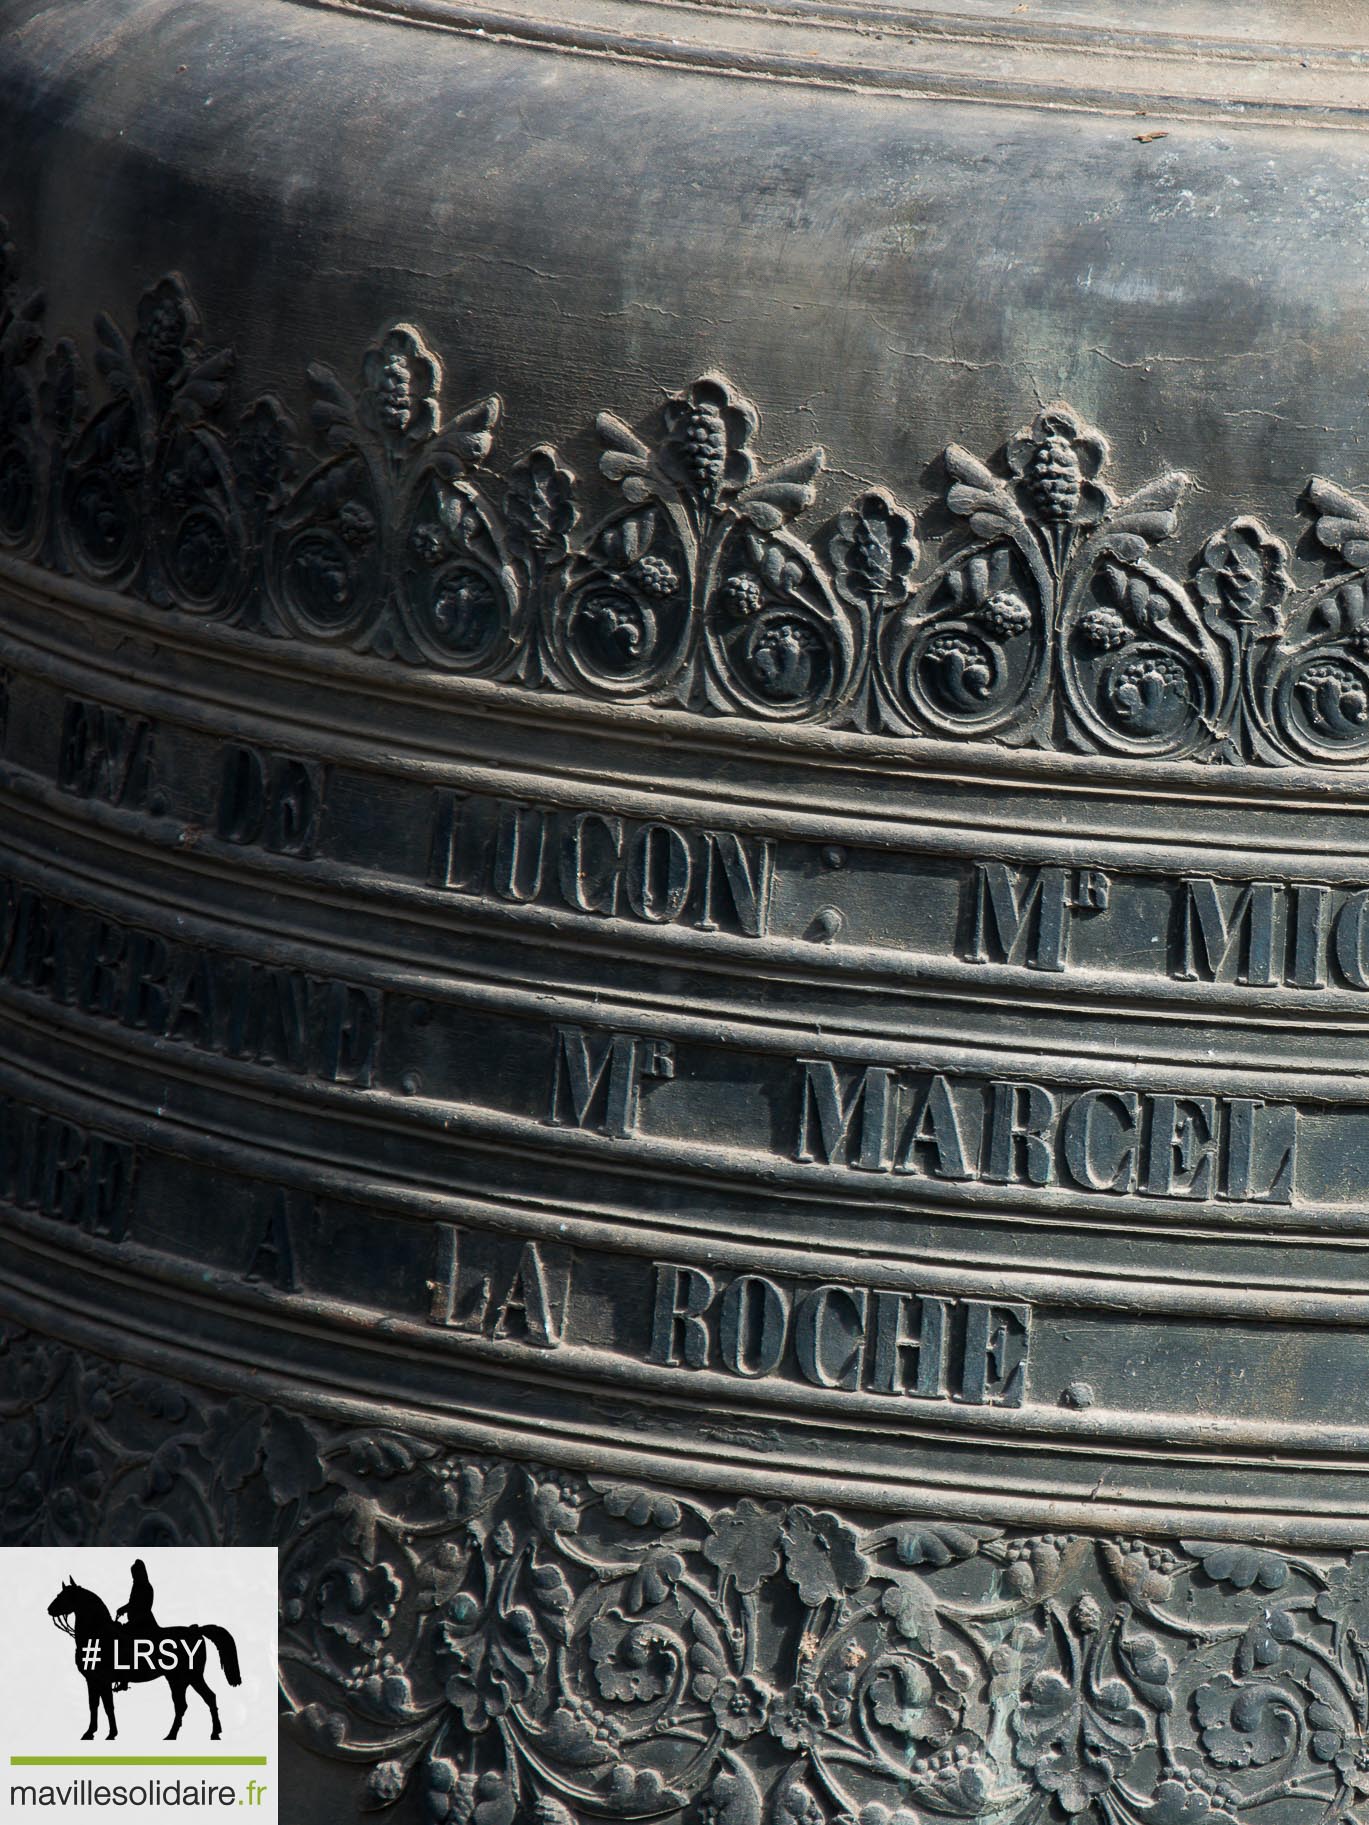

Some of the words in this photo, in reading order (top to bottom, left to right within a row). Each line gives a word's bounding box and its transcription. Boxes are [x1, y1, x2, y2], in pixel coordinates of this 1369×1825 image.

[215, 743, 327, 860] DE
[794, 1058, 1299, 1206] MARCEL
[427, 1221, 571, 1349] LA
